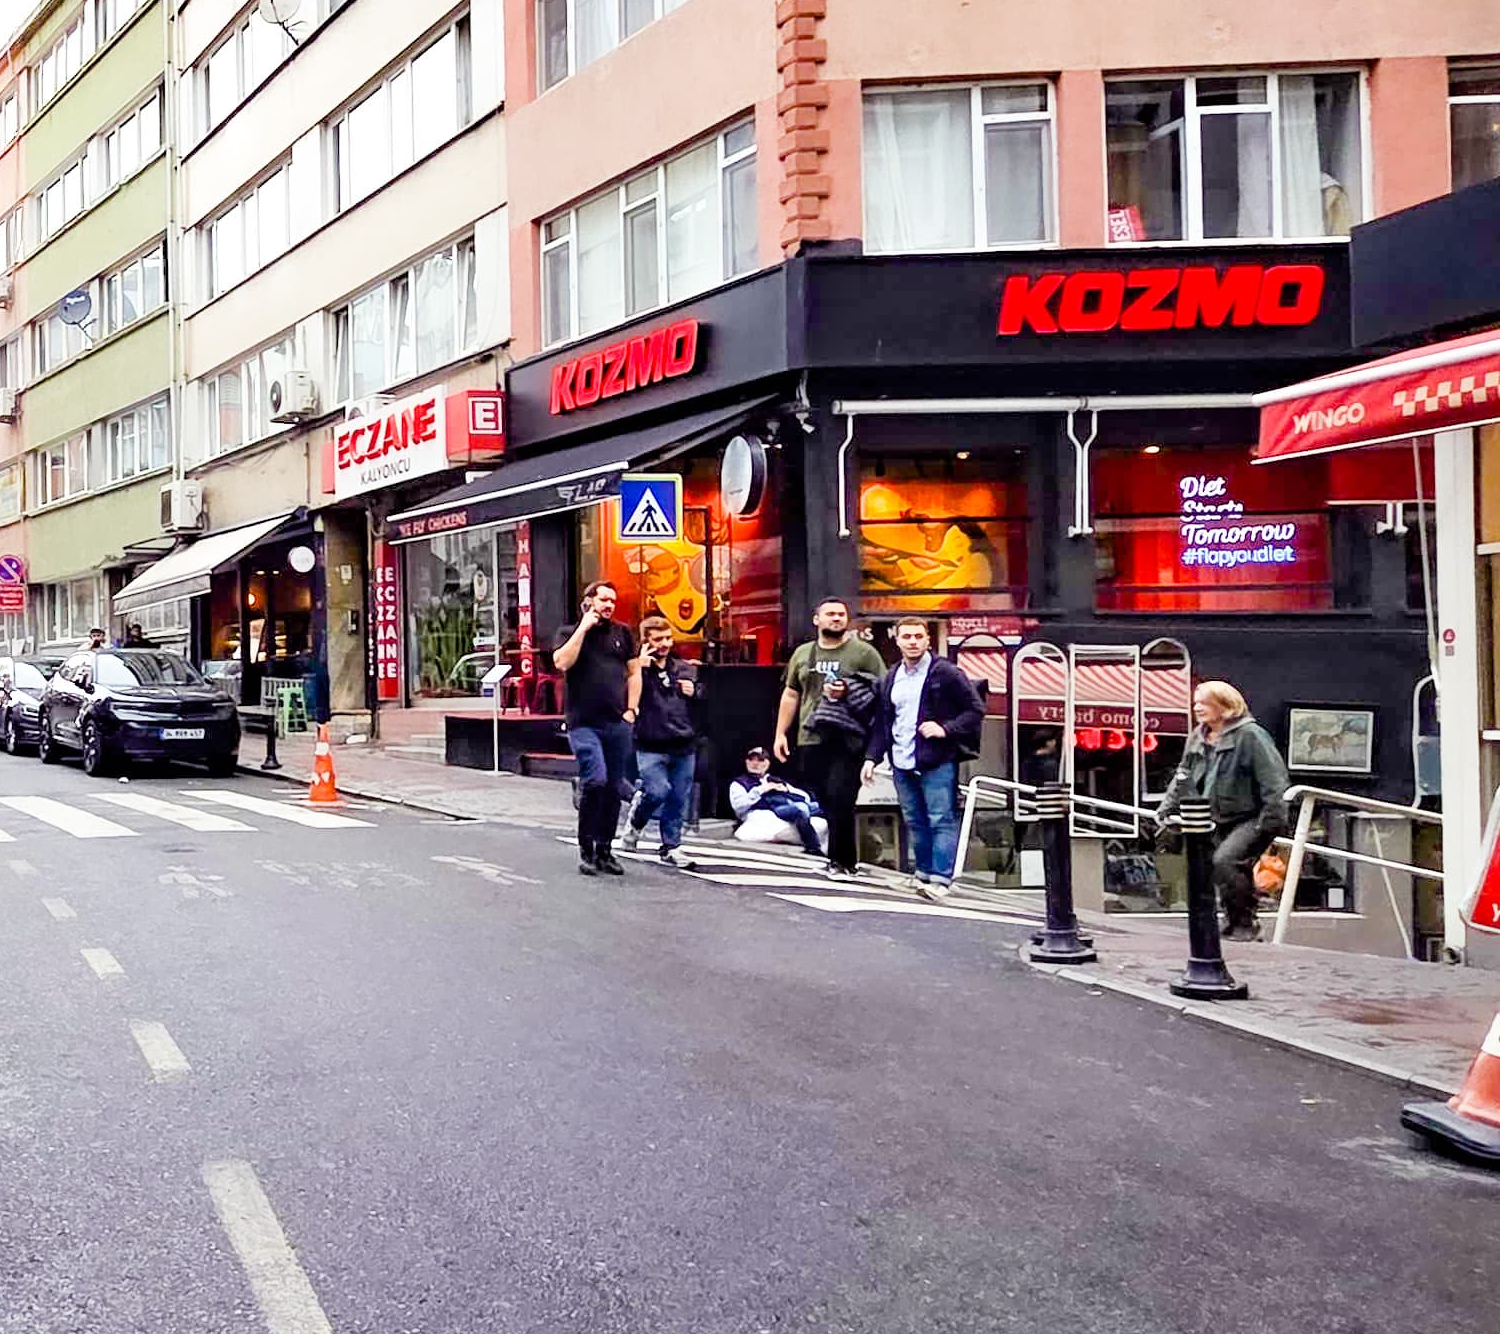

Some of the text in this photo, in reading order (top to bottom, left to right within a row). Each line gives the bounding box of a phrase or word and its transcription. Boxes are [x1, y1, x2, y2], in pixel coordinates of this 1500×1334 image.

[997, 265, 1326, 336] KOZMO
[550, 318, 699, 415] KOZMO
[338, 398, 437, 470] ECZANE
[1293, 402, 1365, 435] WINGO
[359, 458, 411, 486] KALYONCU
[1180, 475, 1226, 499] Diet
[1181, 523, 1297, 545] Tomorrow
[385, 566, 397, 678] ECZANE
